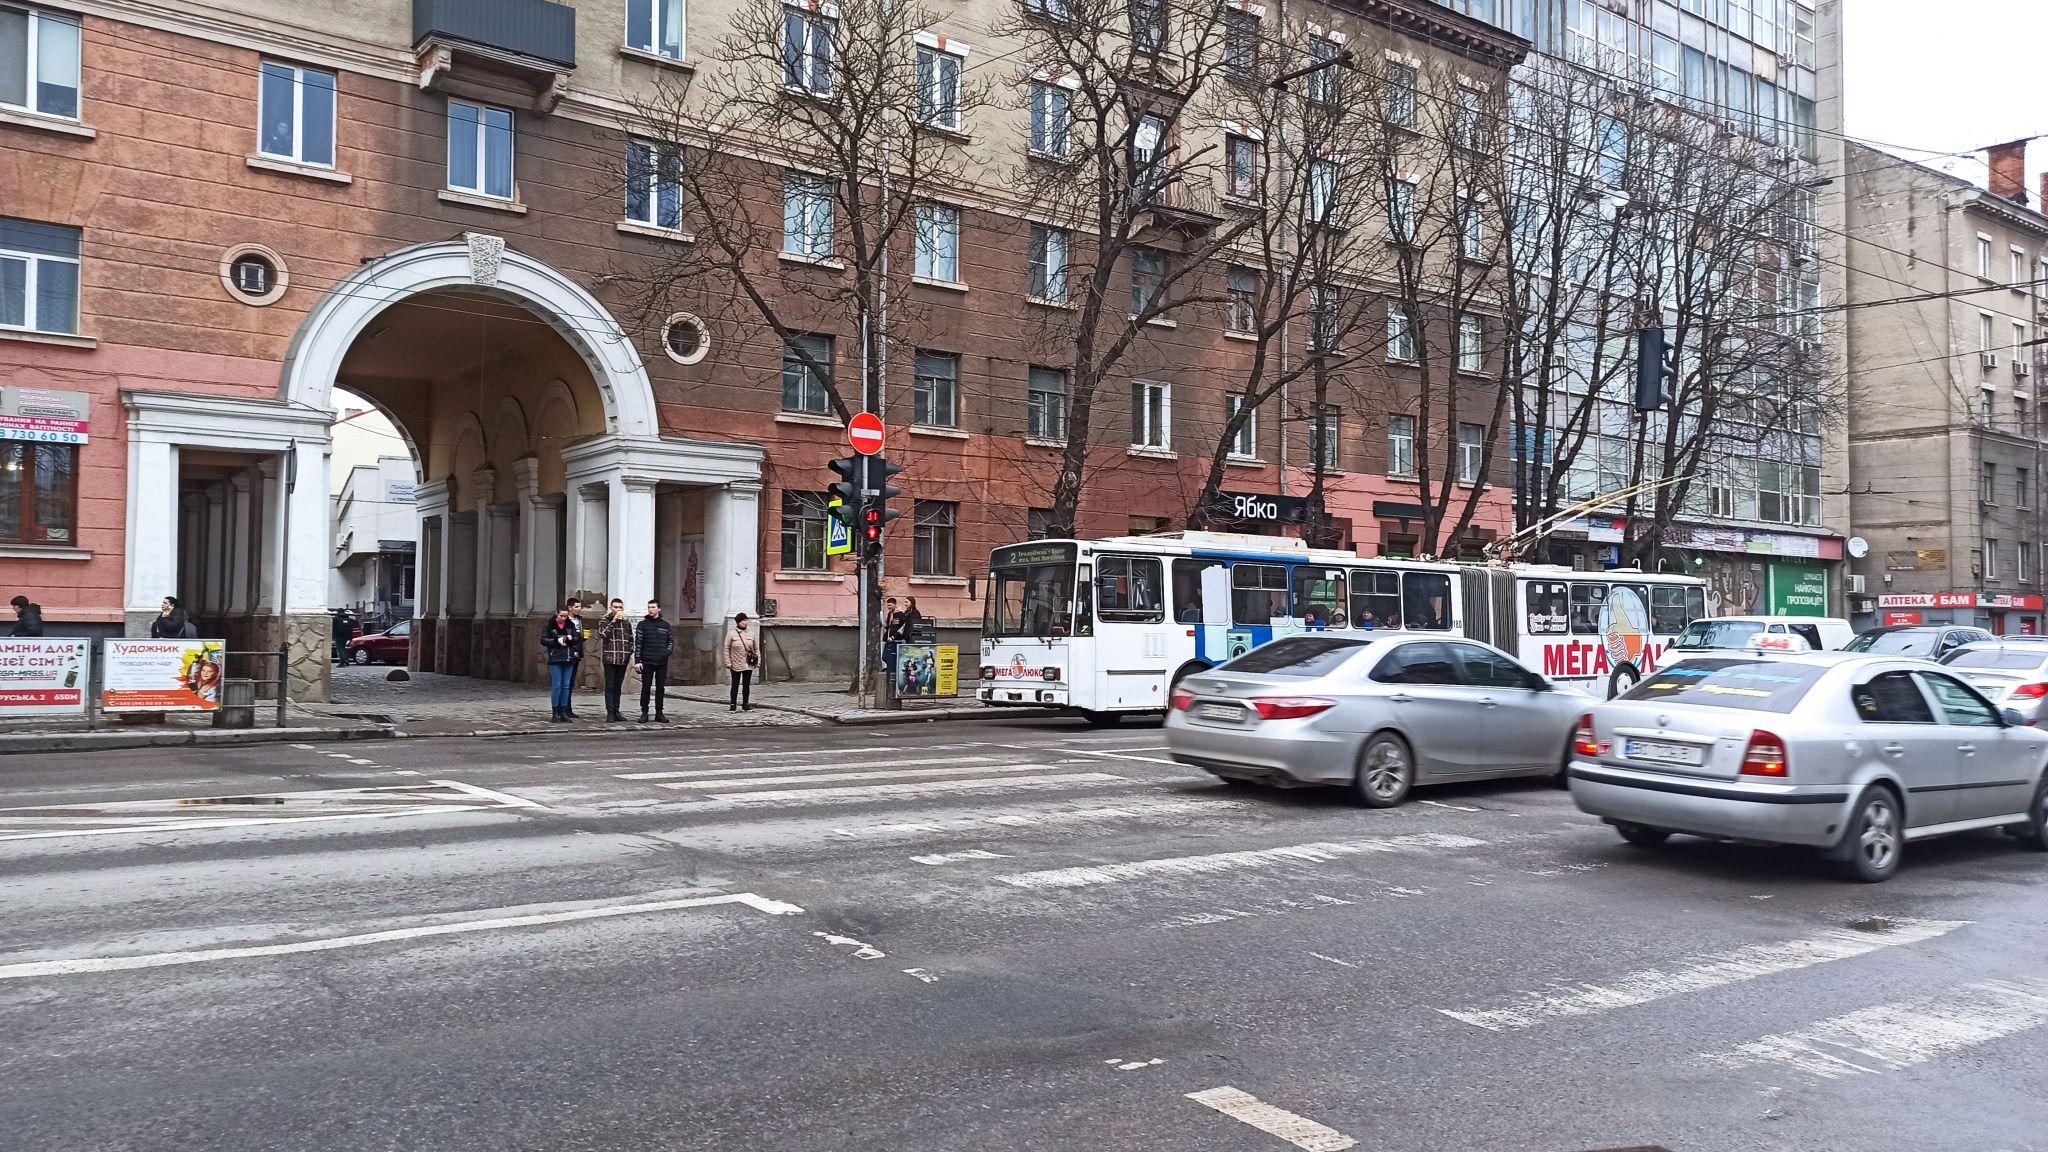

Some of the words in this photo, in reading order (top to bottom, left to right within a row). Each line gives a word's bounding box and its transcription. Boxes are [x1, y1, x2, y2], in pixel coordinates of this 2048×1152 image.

[11, 430, 36, 440] 730
[41, 432, 57, 442] 60
[63, 433, 78, 443] 50
[1234, 495, 1278, 519] Ябко
[1010, 552, 1016, 564] 2
[1883, 596, 1927, 606] АПТЕКА
[1940, 595, 1970, 605] БАМ
[45, 645, 74, 654] ДЛЯ
[112, 642, 180, 656] Художник
[981, 646, 991, 656] 180
[995, 668, 1013, 677] МЕГА
